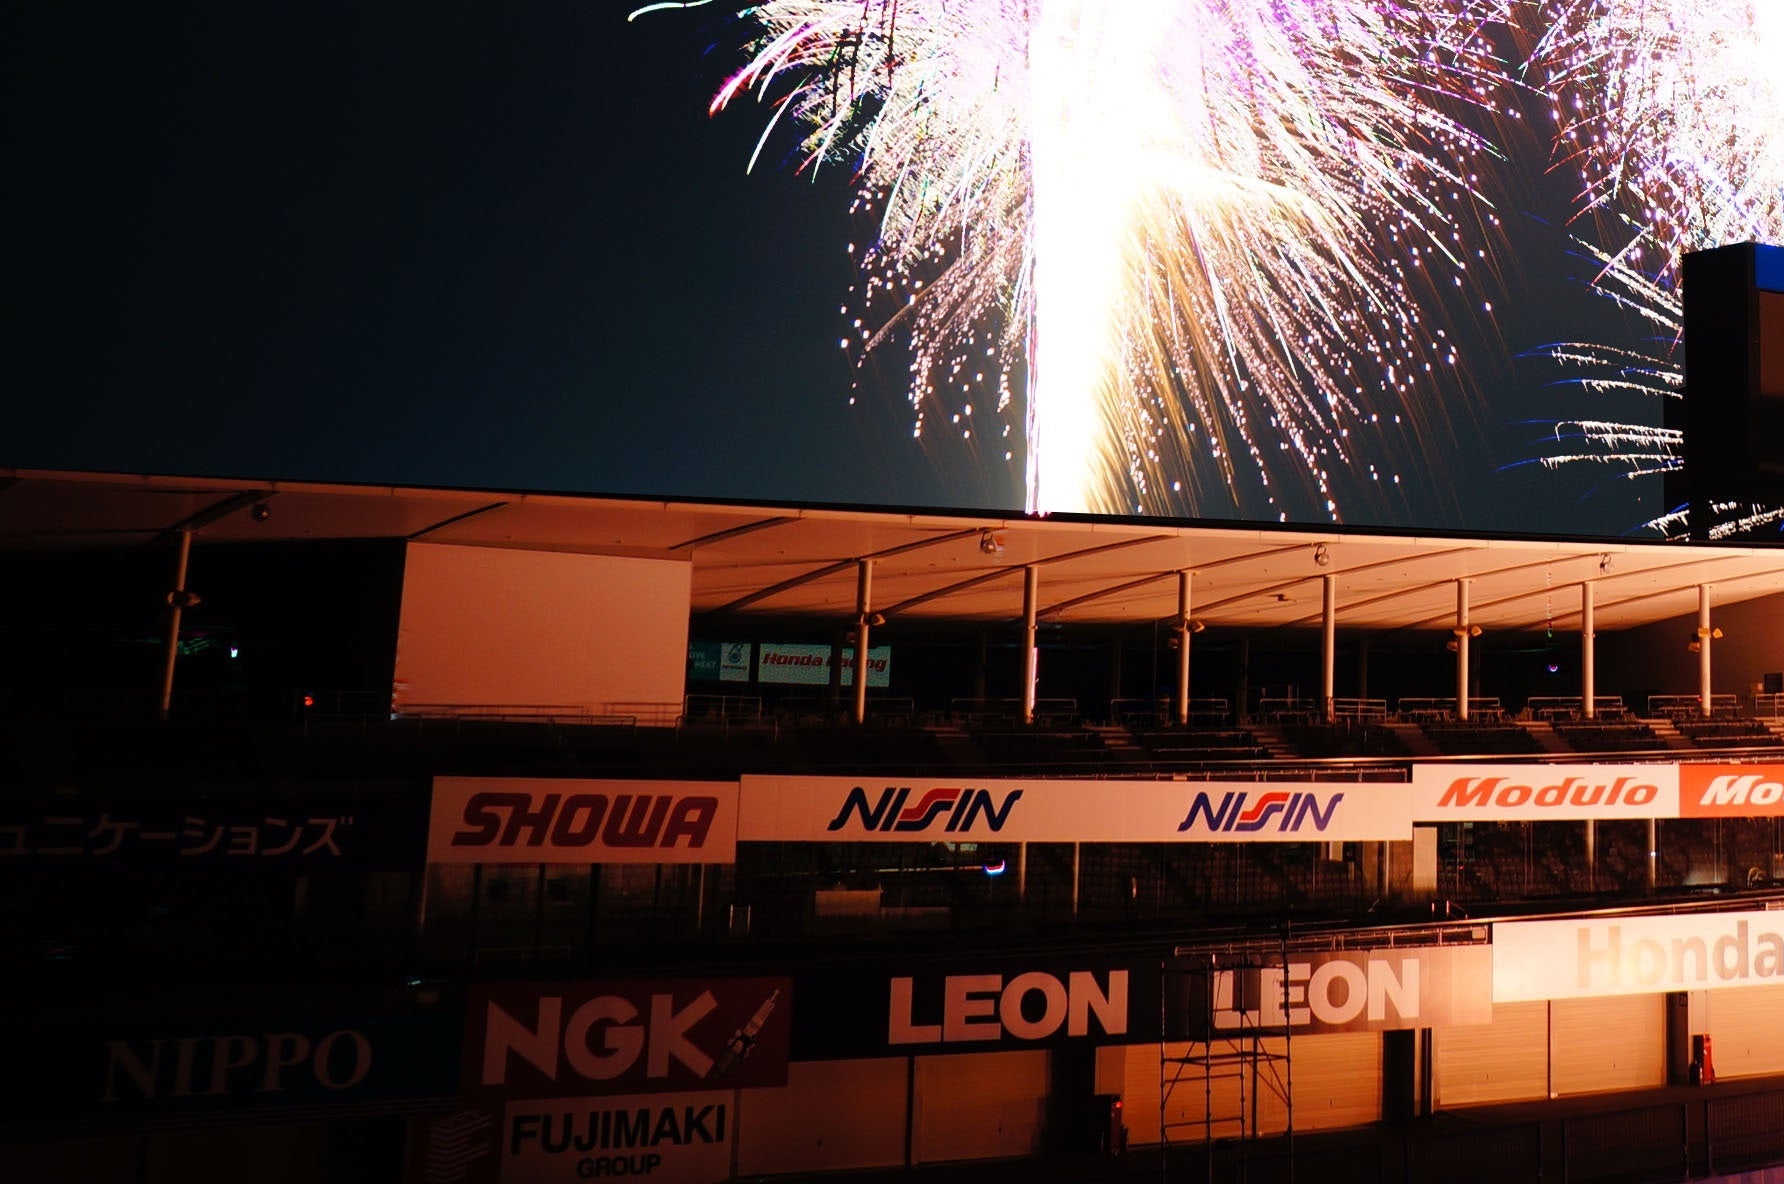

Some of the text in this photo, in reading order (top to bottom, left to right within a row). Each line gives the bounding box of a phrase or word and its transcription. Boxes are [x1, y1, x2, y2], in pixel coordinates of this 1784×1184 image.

[762, 652, 822, 667] Honda
[451, 792, 719, 848] SHOWA
[1437, 777, 1658, 808] Modulo
[889, 970, 1127, 1045] LEON
[1213, 959, 1420, 1030] LEON
[482, 990, 720, 1085] NGK
[99, 1029, 374, 1103] NIPPO
[510, 1105, 725, 1154] FUJIMAKI
[576, 1153, 661, 1178] GROUP
